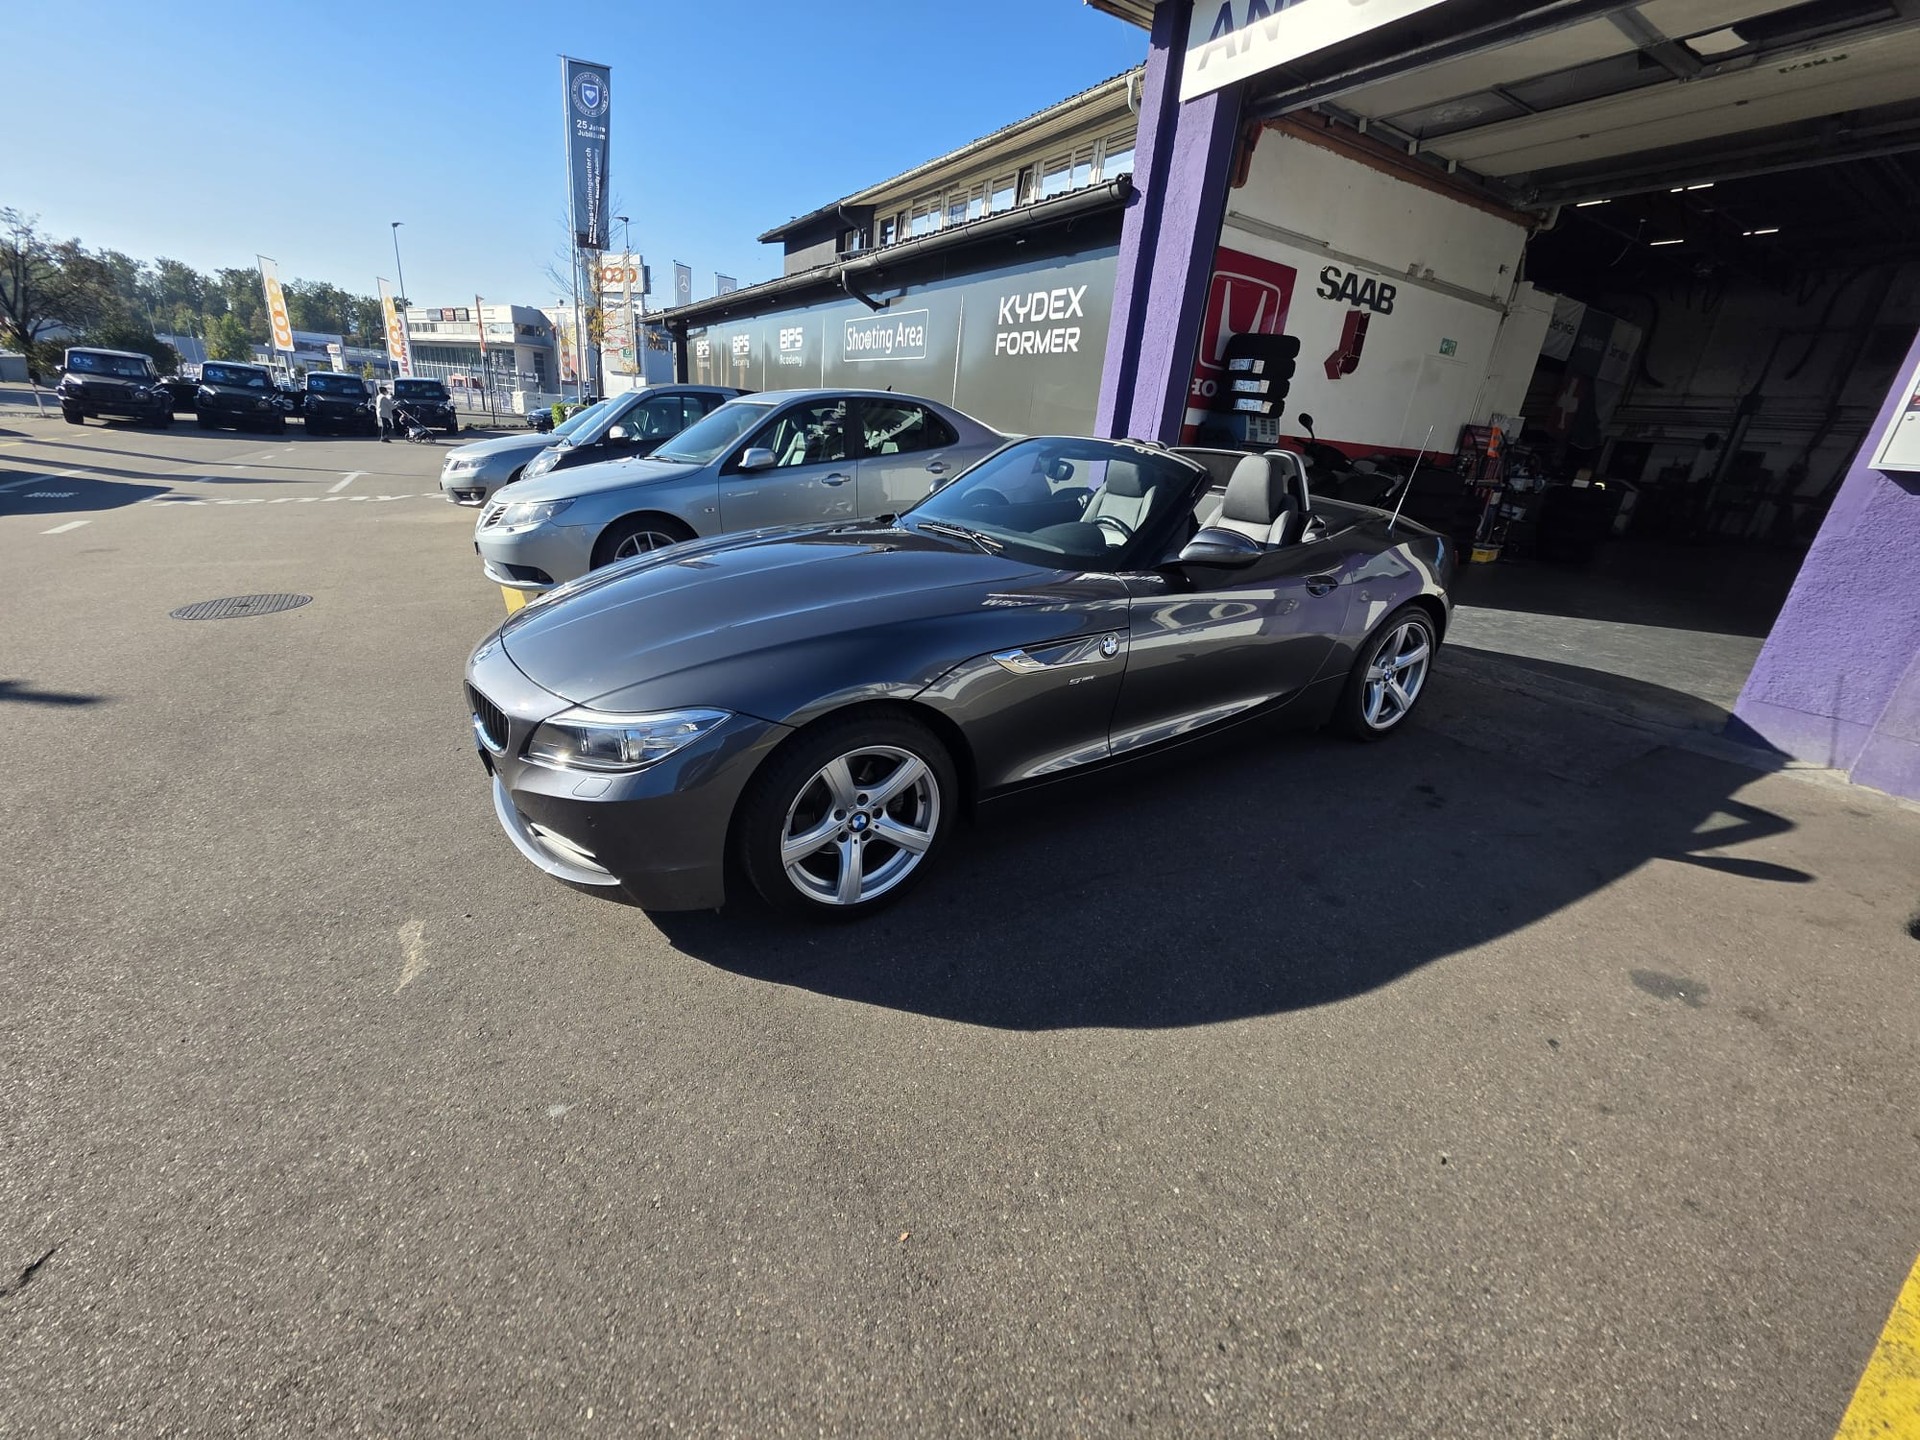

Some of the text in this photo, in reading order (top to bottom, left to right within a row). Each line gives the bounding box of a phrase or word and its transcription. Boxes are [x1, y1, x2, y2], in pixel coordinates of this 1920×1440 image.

[577, 119, 588, 129] 25
[1316, 264, 1397, 315] SAAB
[998, 285, 1088, 325] KYDEX
[697, 340, 709, 356] BPS
[733, 334, 750, 353] BPS
[780, 327, 803, 349] BPS
[846, 322, 923, 354] Shooting Area
[995, 326, 1081, 356] FORMER
